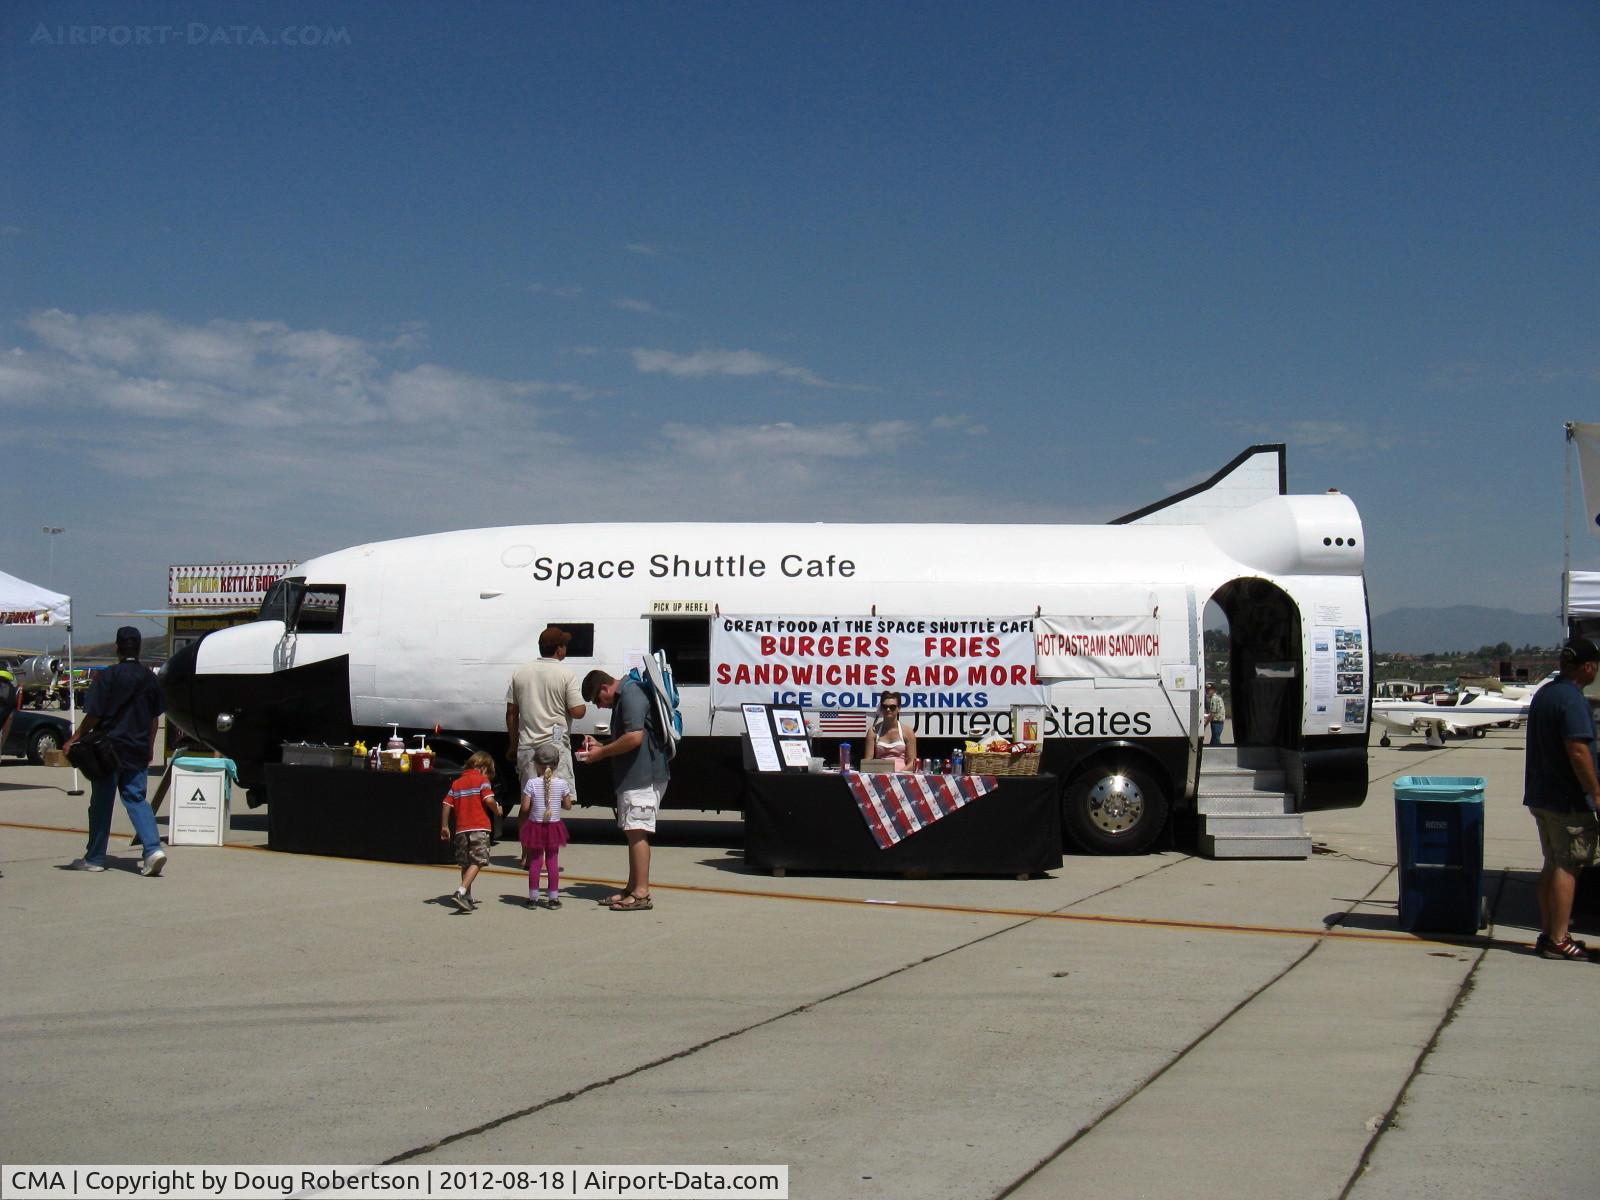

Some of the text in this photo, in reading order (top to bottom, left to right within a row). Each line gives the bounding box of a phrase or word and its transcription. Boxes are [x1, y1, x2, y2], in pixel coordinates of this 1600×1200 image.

[533, 555, 856, 586] Space Shuttle Cafe
[220, 576, 254, 592] KETTLE
[255, 575, 281, 592] COR
[653, 603, 703, 612] PICK UP HERE
[723, 619, 773, 633] GREAT
[777, 619, 818, 633] FOOD
[821, 620, 841, 633] AT
[845, 620, 873, 633] THE
[877, 620, 926, 633] SPACE
[930, 621, 996, 633] SHUTTLE
[761, 636, 1001, 657] BURGERS FRIES
[1036, 634, 1160, 657] HOT PASTRAMI SANDWICH
[717, 664, 896, 686] SANDWICHES
[904, 665, 959, 686] AND
[773, 692, 813, 707] ICE
[900, 692, 988, 708] DRINKS
